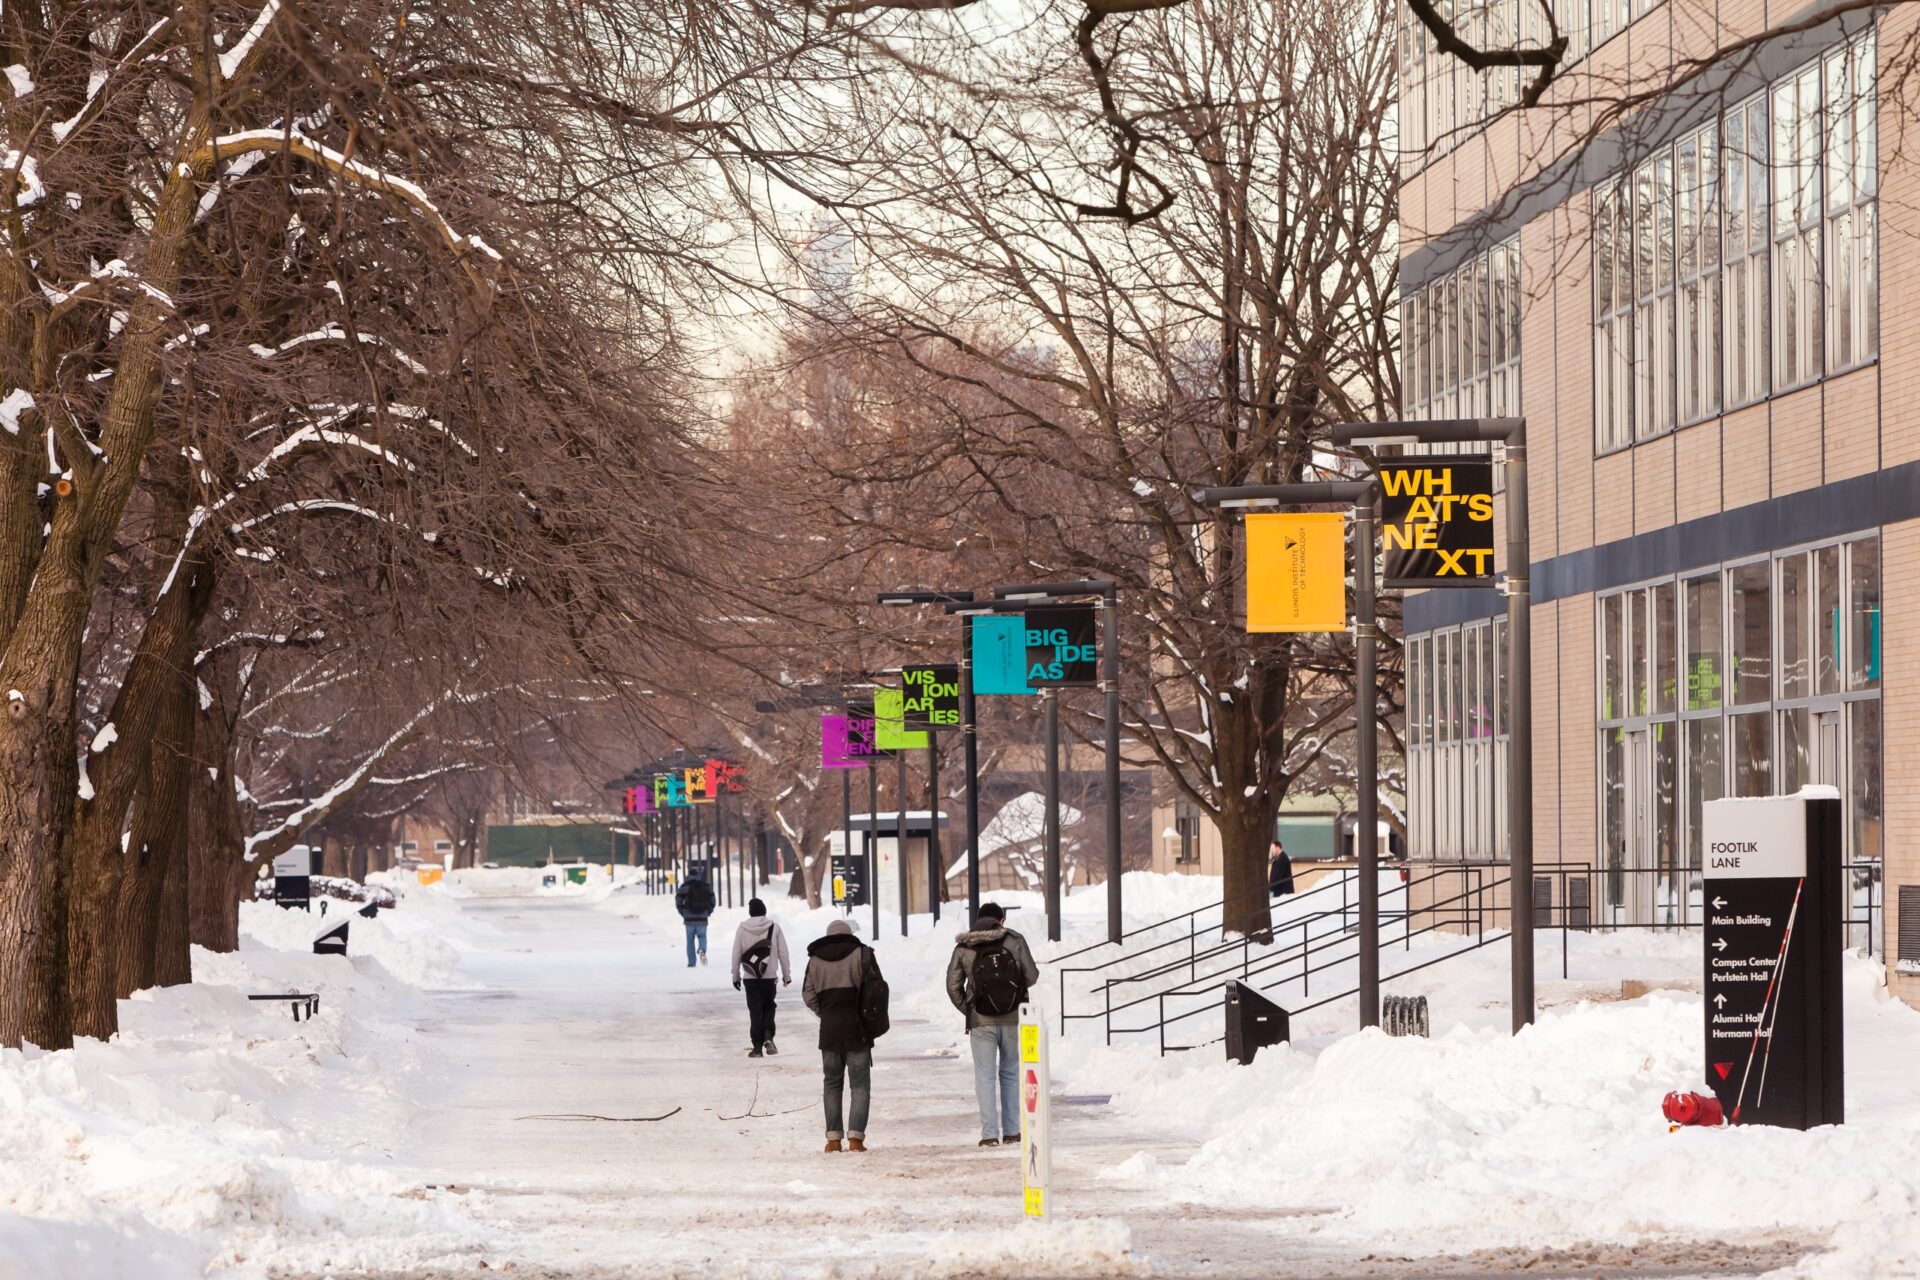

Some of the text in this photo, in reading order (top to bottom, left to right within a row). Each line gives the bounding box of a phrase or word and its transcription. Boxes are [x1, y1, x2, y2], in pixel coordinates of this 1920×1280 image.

[1380, 468, 1451, 496] WH
[1404, 493, 1493, 523] AT'S
[1383, 523, 1438, 550] NE
[1435, 548, 1494, 576] XT
[1300, 580, 1306, 590] OF
[1025, 628, 1069, 647] BIG
[1055, 644, 1097, 663] IDE
[902, 670, 935, 684] VIS
[1027, 662, 1065, 681] AS
[923, 683, 959, 698] ION
[903, 697, 935, 712] AR
[929, 709, 960, 724] IES
[1711, 842, 1758, 853] FOOTLIK
[1711, 857, 1741, 868] LANE
[1711, 914, 1772, 927] Main Building
[1712, 957, 1778, 969] Campus Center
[1712, 971, 1768, 982] Perlstein Hall
[1712, 1012, 1744, 1023] Alumni
[1712, 1028, 1753, 1038] Hermann
